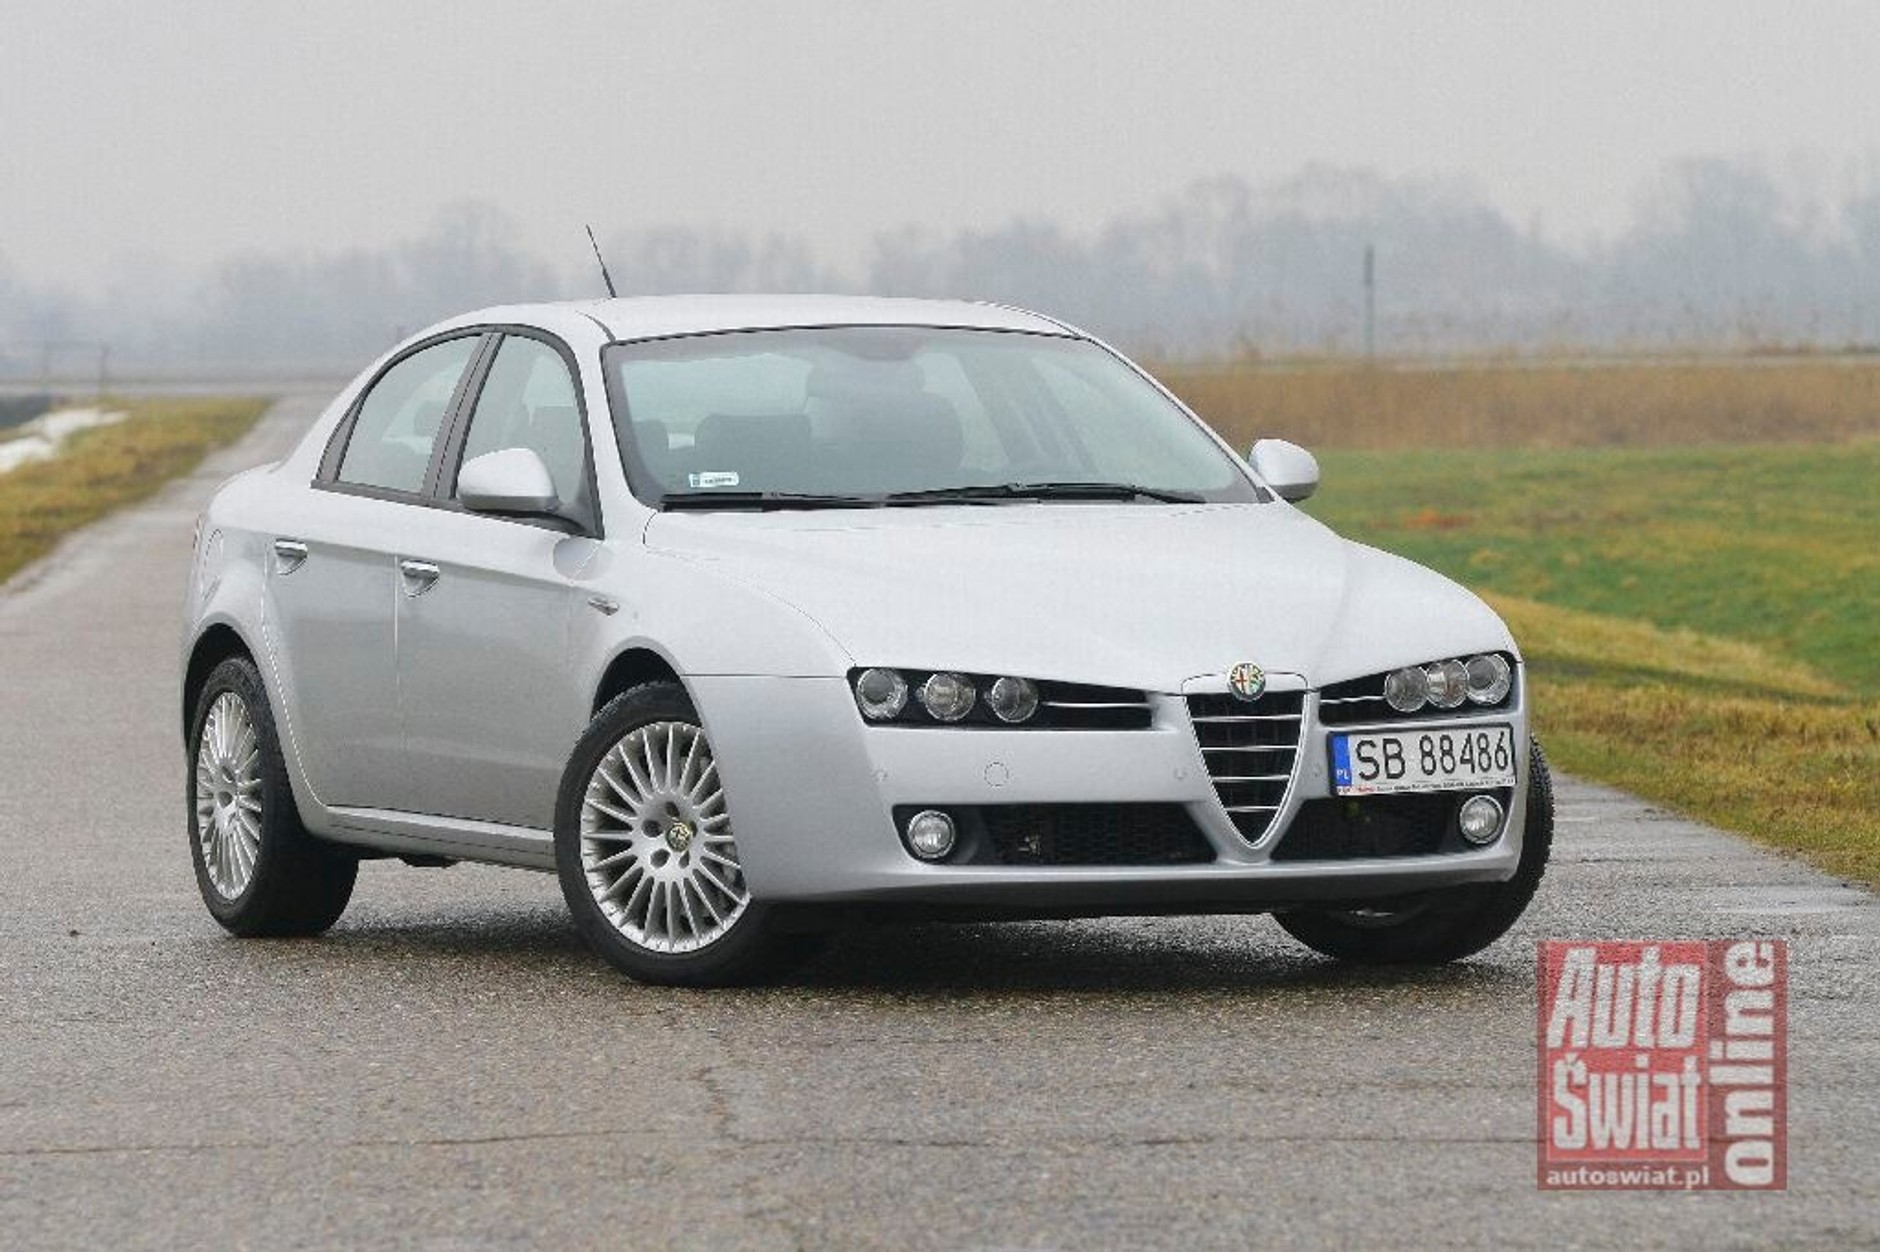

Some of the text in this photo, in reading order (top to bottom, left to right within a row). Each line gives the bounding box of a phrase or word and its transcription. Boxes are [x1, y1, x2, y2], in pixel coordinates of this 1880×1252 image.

[1355, 731, 1508, 781] SB 88486
[1336, 769, 1349, 780] PL
